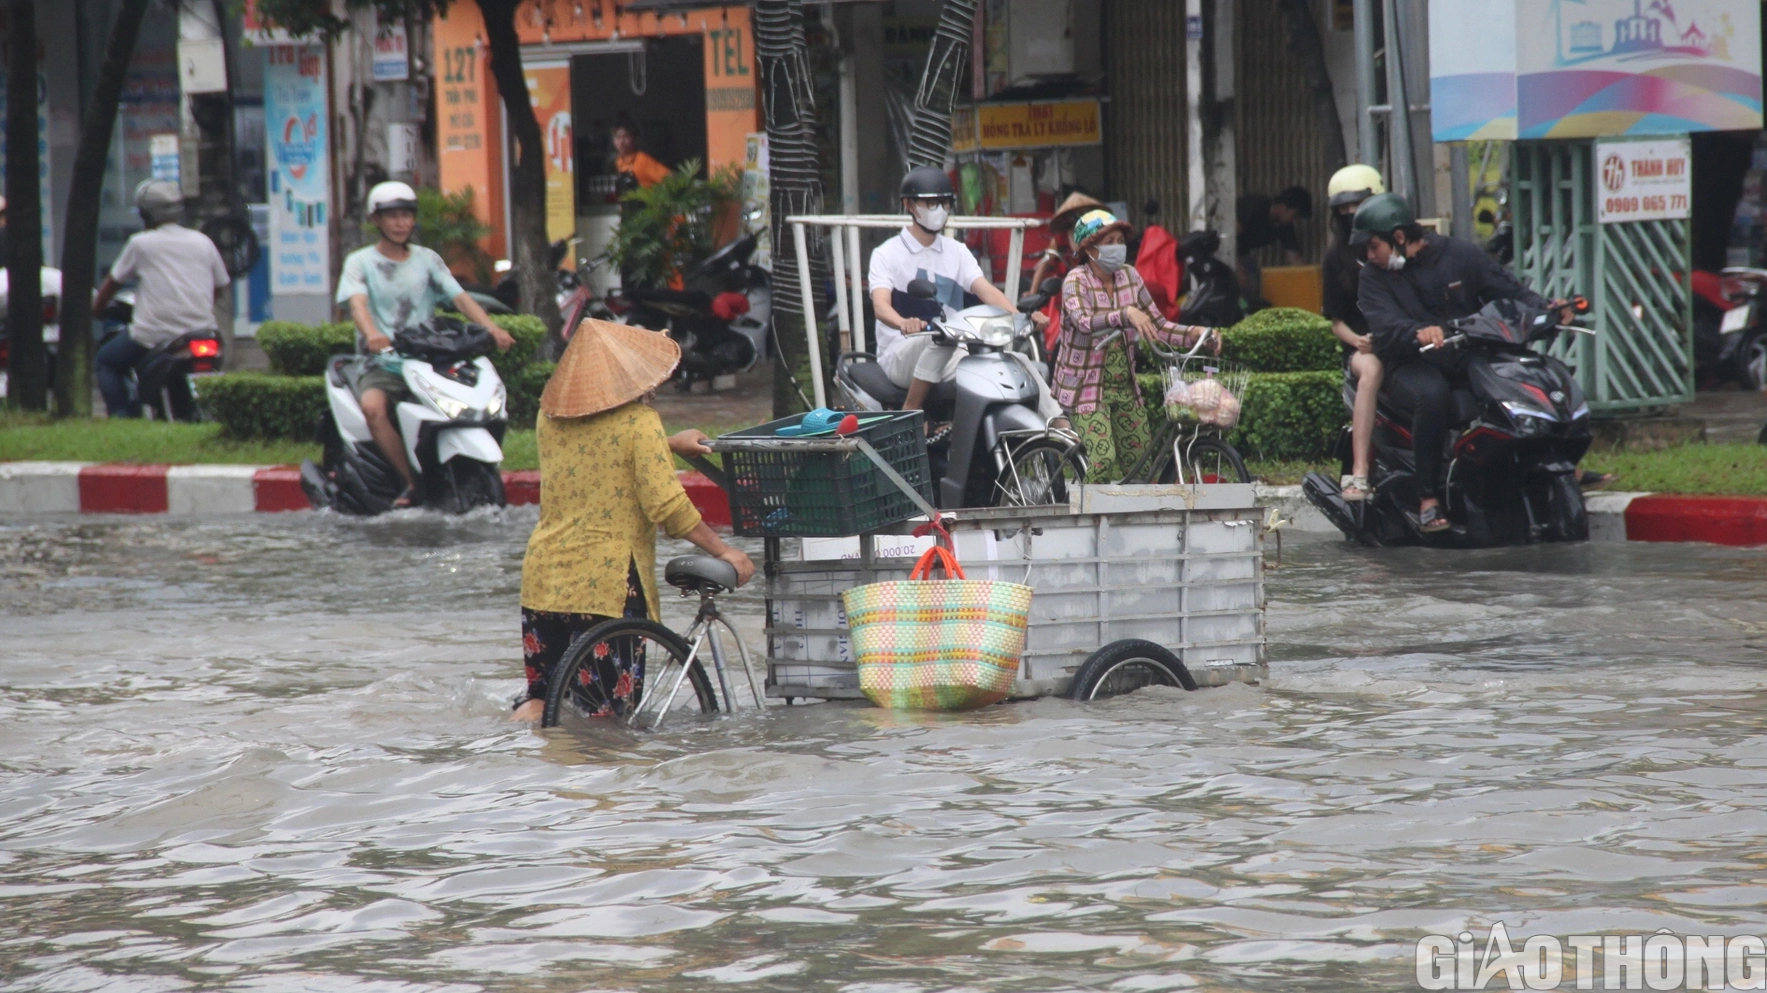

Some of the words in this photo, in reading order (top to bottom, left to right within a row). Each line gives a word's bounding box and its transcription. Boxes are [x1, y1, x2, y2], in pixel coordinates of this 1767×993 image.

[445, 47, 475, 82] 127
[710, 28, 749, 76] TEL
[1606, 197, 1639, 213] 0909
[1642, 195, 1666, 211] 065
[1670, 194, 1687, 209] 771
